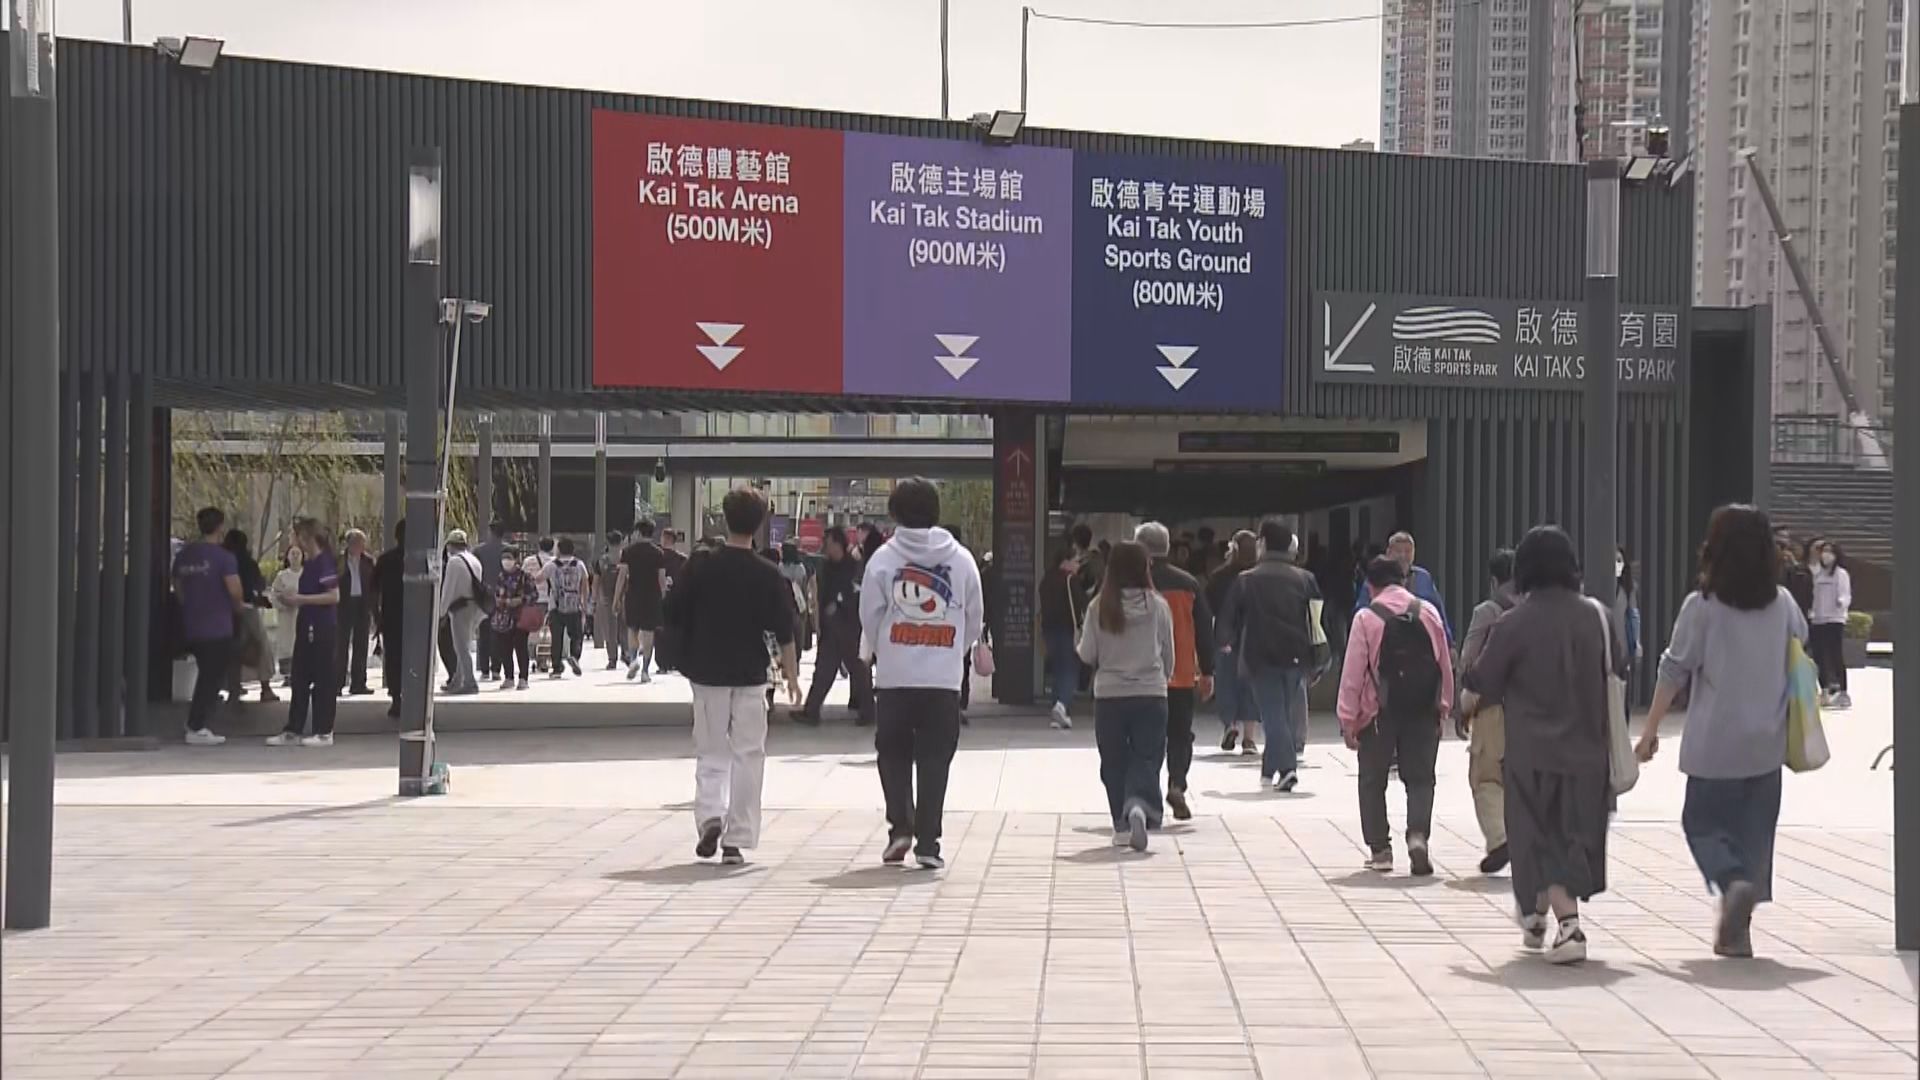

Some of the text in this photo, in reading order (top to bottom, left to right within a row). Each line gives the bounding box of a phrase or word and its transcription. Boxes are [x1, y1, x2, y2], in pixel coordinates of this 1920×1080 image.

[646, 142, 791, 187] 啟德體藝館
[890, 161, 1024, 202] 啟德主場館
[638, 180, 799, 214] Kai Tak Arena
[1090, 177, 1266, 219] 啟德青年運動場
[667, 213, 773, 249] (500M米)
[870, 200, 1043, 234] Kai Tak Stadium
[1107, 213, 1244, 244] Kai Tak Youth
[908, 237, 1006, 273] (900M米)
[1104, 243, 1251, 274] Sports Ground
[1132, 278, 1223, 311] (800M米)
[1515, 307, 1678, 349] 啟德育園
[1392, 344, 1431, 374] 啟德
[1434, 347, 1472, 362] KAI TAK
[1434, 361, 1498, 376] SPORTS PARK
[1513, 353, 1539, 378] KAI
[1543, 355, 1572, 379] TAK
[1638, 358, 1675, 382] PARK
